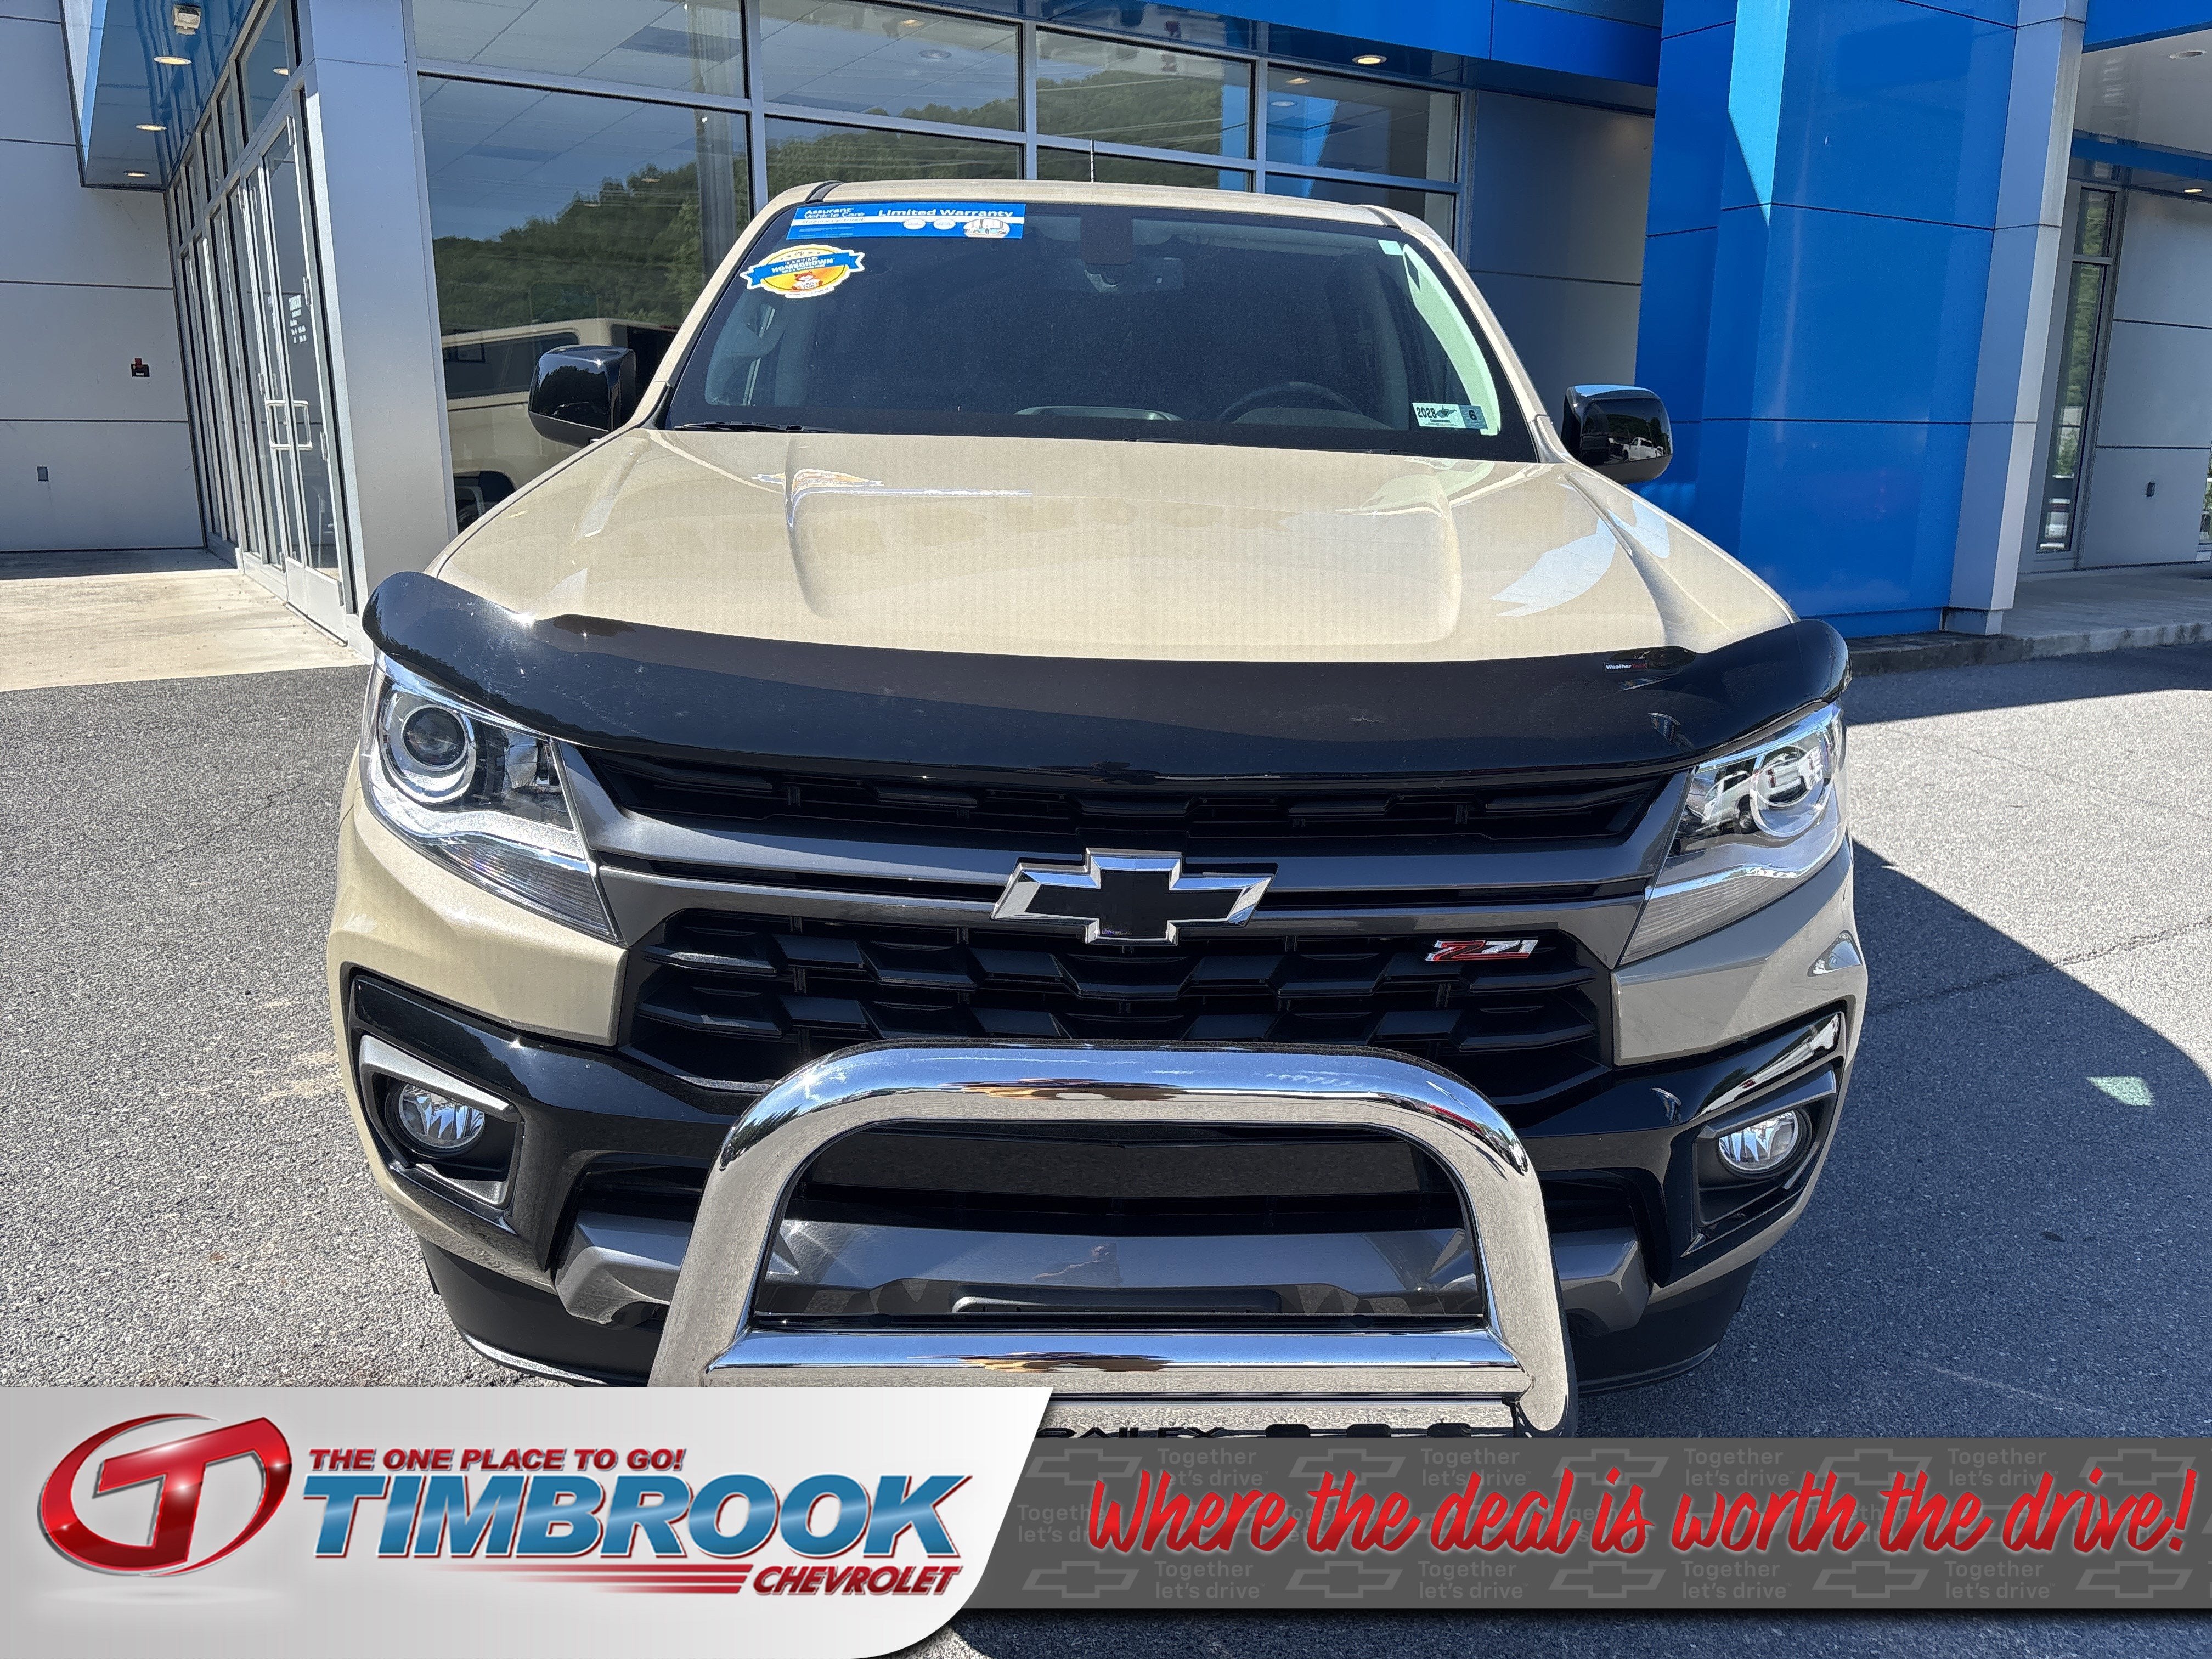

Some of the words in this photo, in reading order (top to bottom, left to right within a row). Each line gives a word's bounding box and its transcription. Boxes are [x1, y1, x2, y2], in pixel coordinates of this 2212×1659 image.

[940, 209, 1014, 217] Warranty
[771, 258, 833, 273] HOMEGROWN
[1416, 407, 1437, 419] 2028
[1468, 410, 1477, 421] 6
[1425, 939, 1539, 961] Z71
